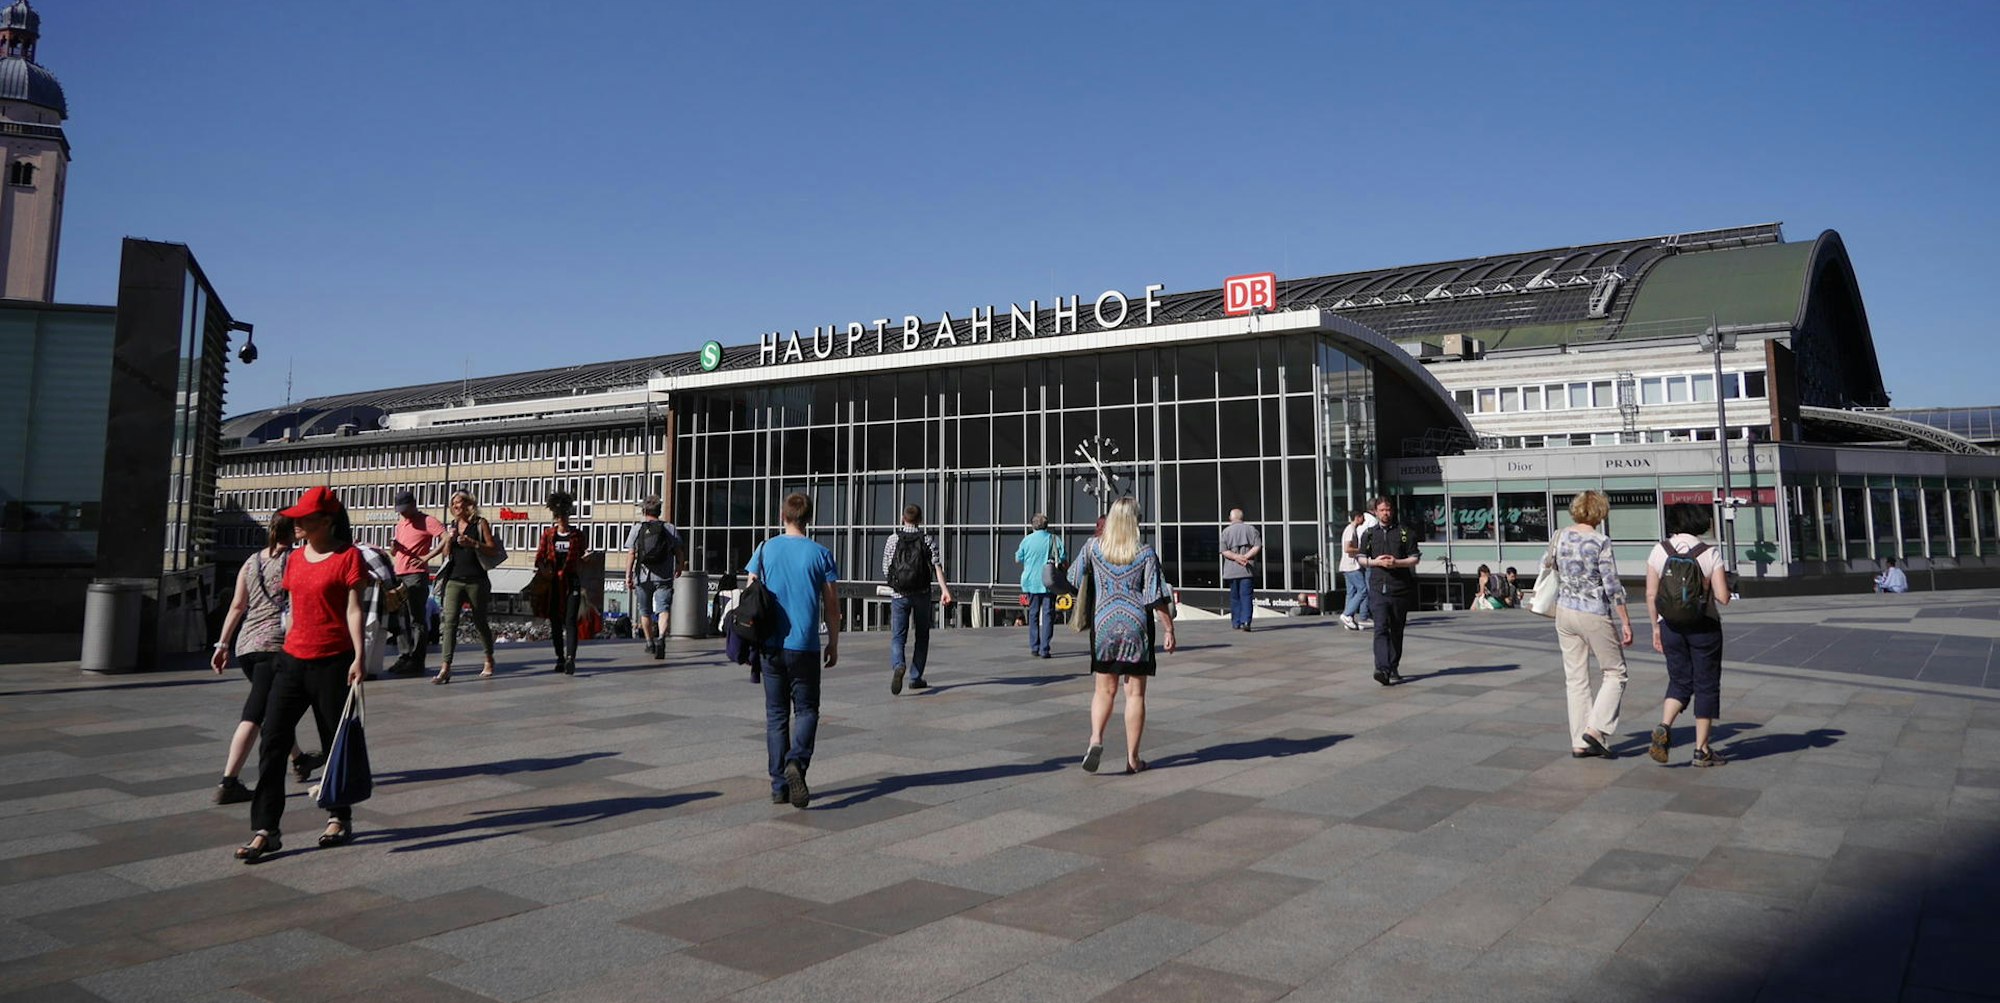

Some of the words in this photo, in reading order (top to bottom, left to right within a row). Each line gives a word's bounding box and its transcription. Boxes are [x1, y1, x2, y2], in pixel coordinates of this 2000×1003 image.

[1231, 279, 1268, 309] DB
[760, 284, 1164, 366] HAUPTBAHNHOF
[703, 342, 719, 368] S
[1508, 461, 1533, 472] Dior
[1606, 458, 1651, 469] PRADA
